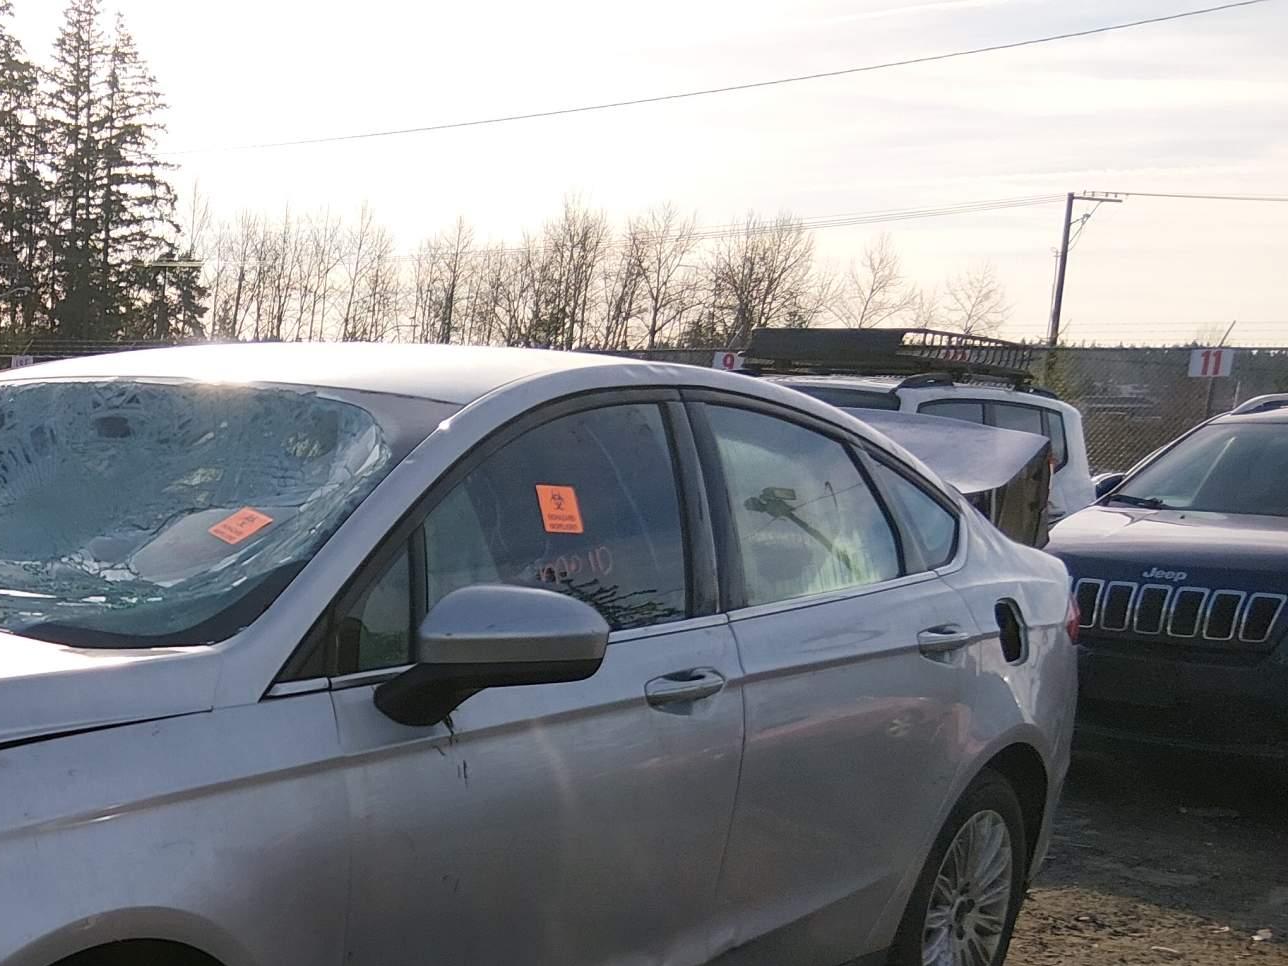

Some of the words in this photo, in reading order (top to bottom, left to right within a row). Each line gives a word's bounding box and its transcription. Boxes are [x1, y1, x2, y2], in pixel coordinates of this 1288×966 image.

[723, 352, 735, 370] 9
[1201, 350, 1223, 376] 11
[1142, 567, 1188, 582] Jeep
